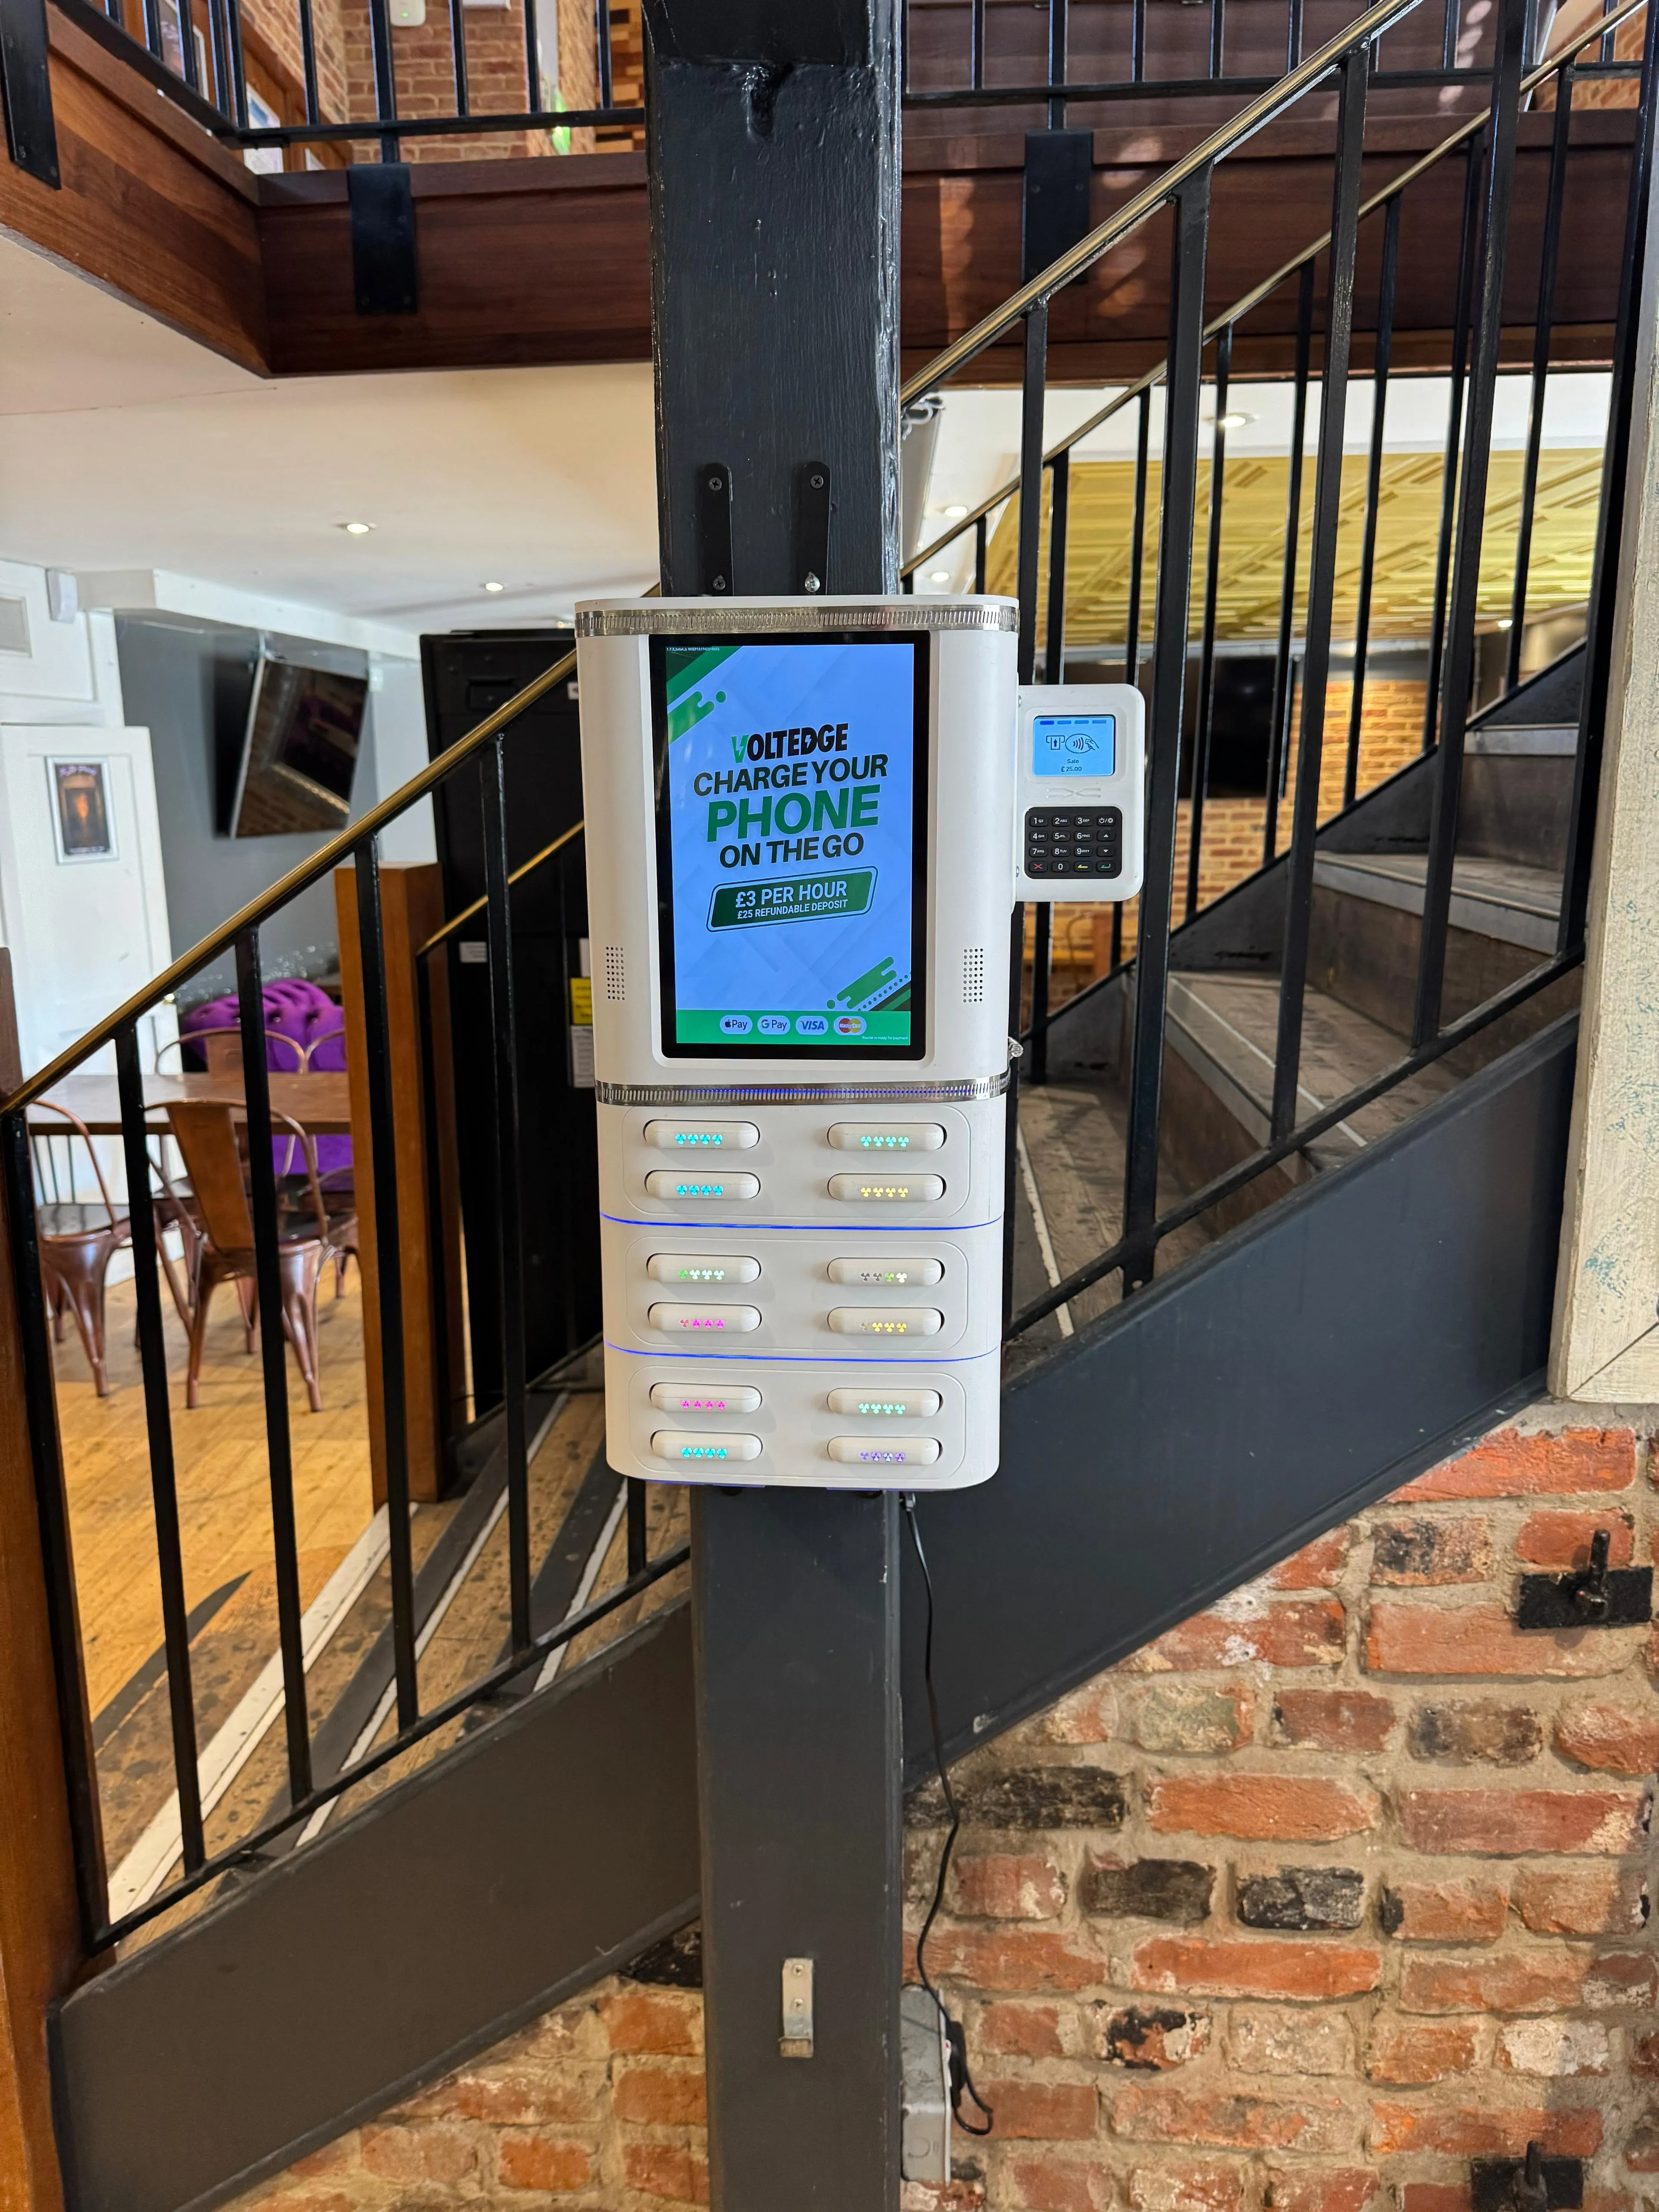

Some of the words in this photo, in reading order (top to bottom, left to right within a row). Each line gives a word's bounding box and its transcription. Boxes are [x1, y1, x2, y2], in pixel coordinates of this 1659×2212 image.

[731, 723, 849, 763] VOLTEDGE
[694, 763, 807, 796] CHARGE
[811, 754, 888, 783] YOUR
[707, 784, 880, 842] PHONE
[719, 842, 760, 868] ON
[766, 837, 819, 863] THE
[822, 833, 864, 858] GO
[735, 890, 756, 908] £3
[761, 887, 794, 905] PER
[799, 880, 847, 900] HOUR
[737, 910, 753, 919] £25
[755, 903, 810, 917] REFUNDABLE
[811, 899, 848, 912] DEPOSIT
[732, 1020, 747, 1030] Pay
[772, 1020, 787, 1031] Pay
[801, 1020, 825, 1030] VISA
